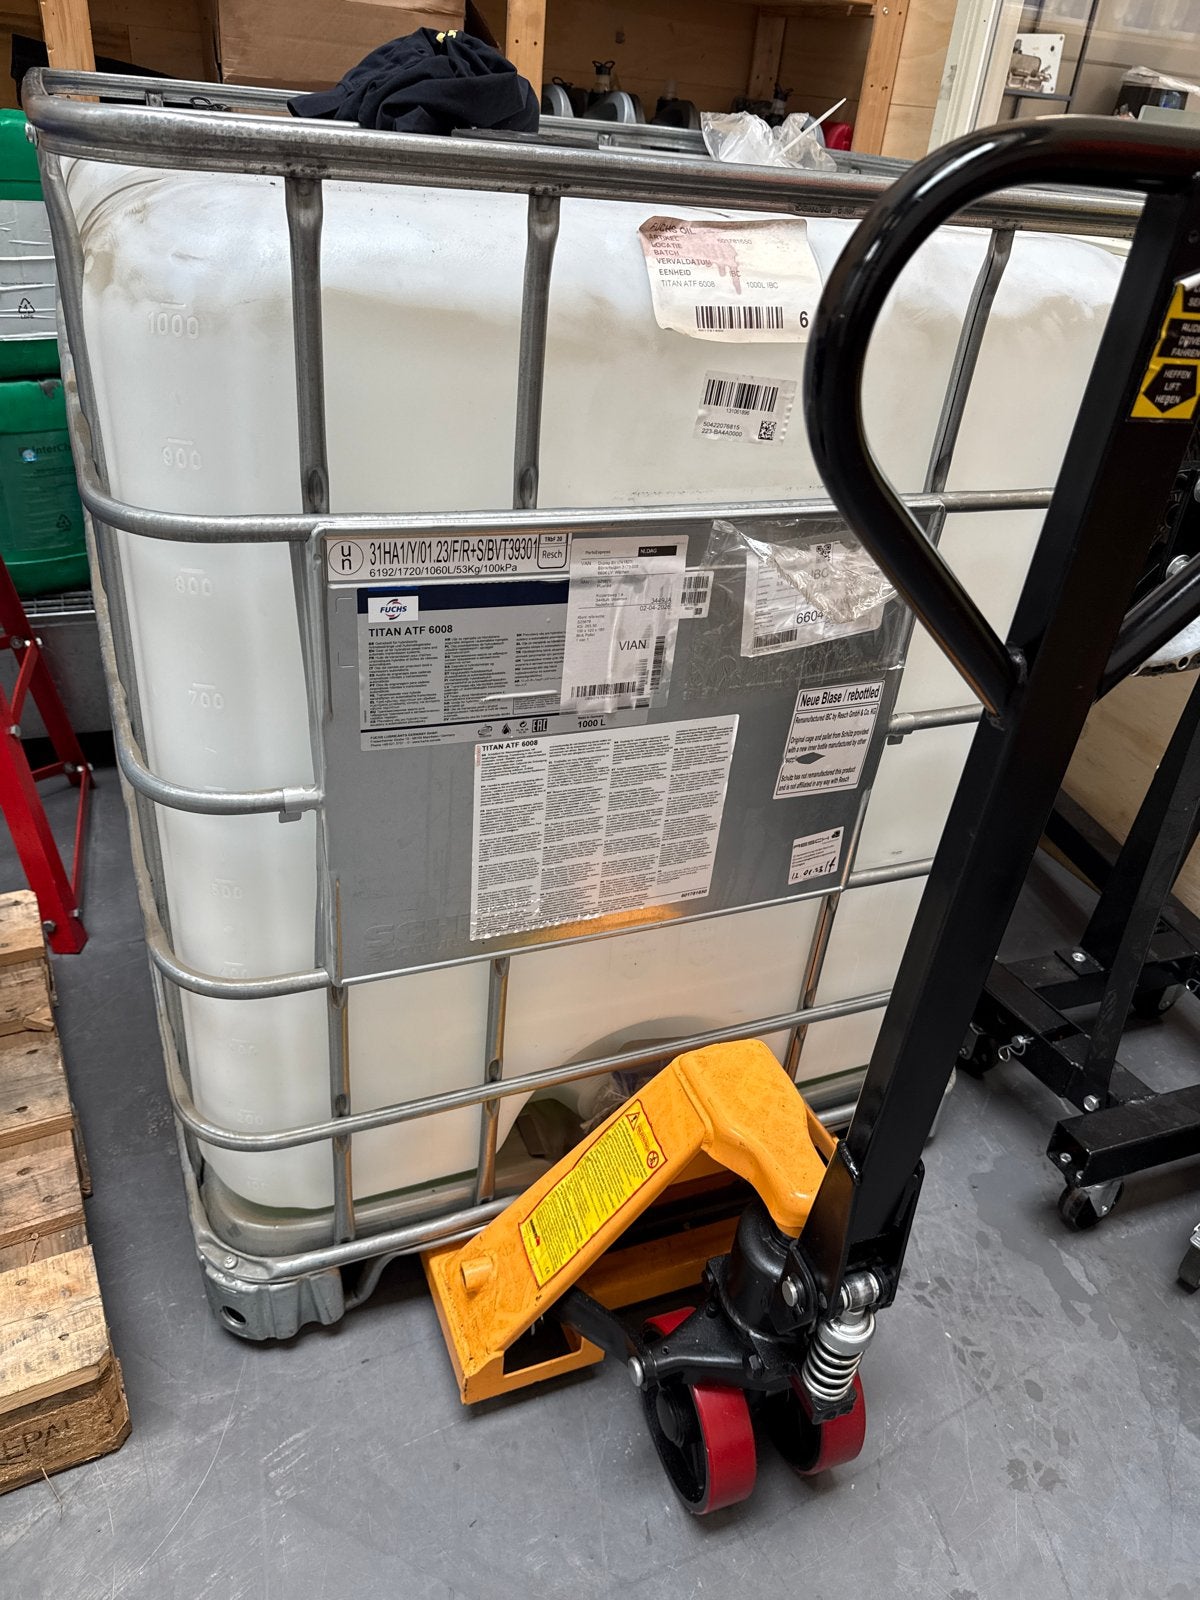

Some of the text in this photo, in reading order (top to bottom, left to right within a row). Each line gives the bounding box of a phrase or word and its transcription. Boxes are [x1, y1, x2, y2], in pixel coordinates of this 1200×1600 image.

[680, 227, 696, 235] OIL
[649, 234, 680, 242] ARTIKEL
[657, 258, 712, 267] VERVALDATUM
[685, 280, 697, 288] ATF
[698, 280, 716, 288] 6008
[148, 311, 199, 340] 1000
[800, 311, 808, 328] 6
[1164, 370, 1192, 379] HEFFEN
[1164, 382, 1182, 391] LIFT
[162, 446, 202, 471] 900
[369, 537, 538, 567] 31HA1/Y/01.23/F/R+S/BVT39301
[542, 549, 563, 560] Resch
[369, 563, 518, 579] 6192/1720/1060L/53Kg/100kPa
[176, 576, 212, 596] 800
[380, 605, 408, 614] FUCHS
[797, 610, 824, 624] 6604
[368, 624, 453, 638] TITAN ATF 6008
[618, 640, 647, 650] VIAN
[189, 690, 224, 709] 700
[800, 694, 820, 707] Neue
[821, 692, 842, 704] Blase
[847, 685, 881, 701] rebottled
[578, 718, 606, 729] 1000 L
[482, 744, 504, 752] TITAN
[522, 740, 538, 748] 6008
